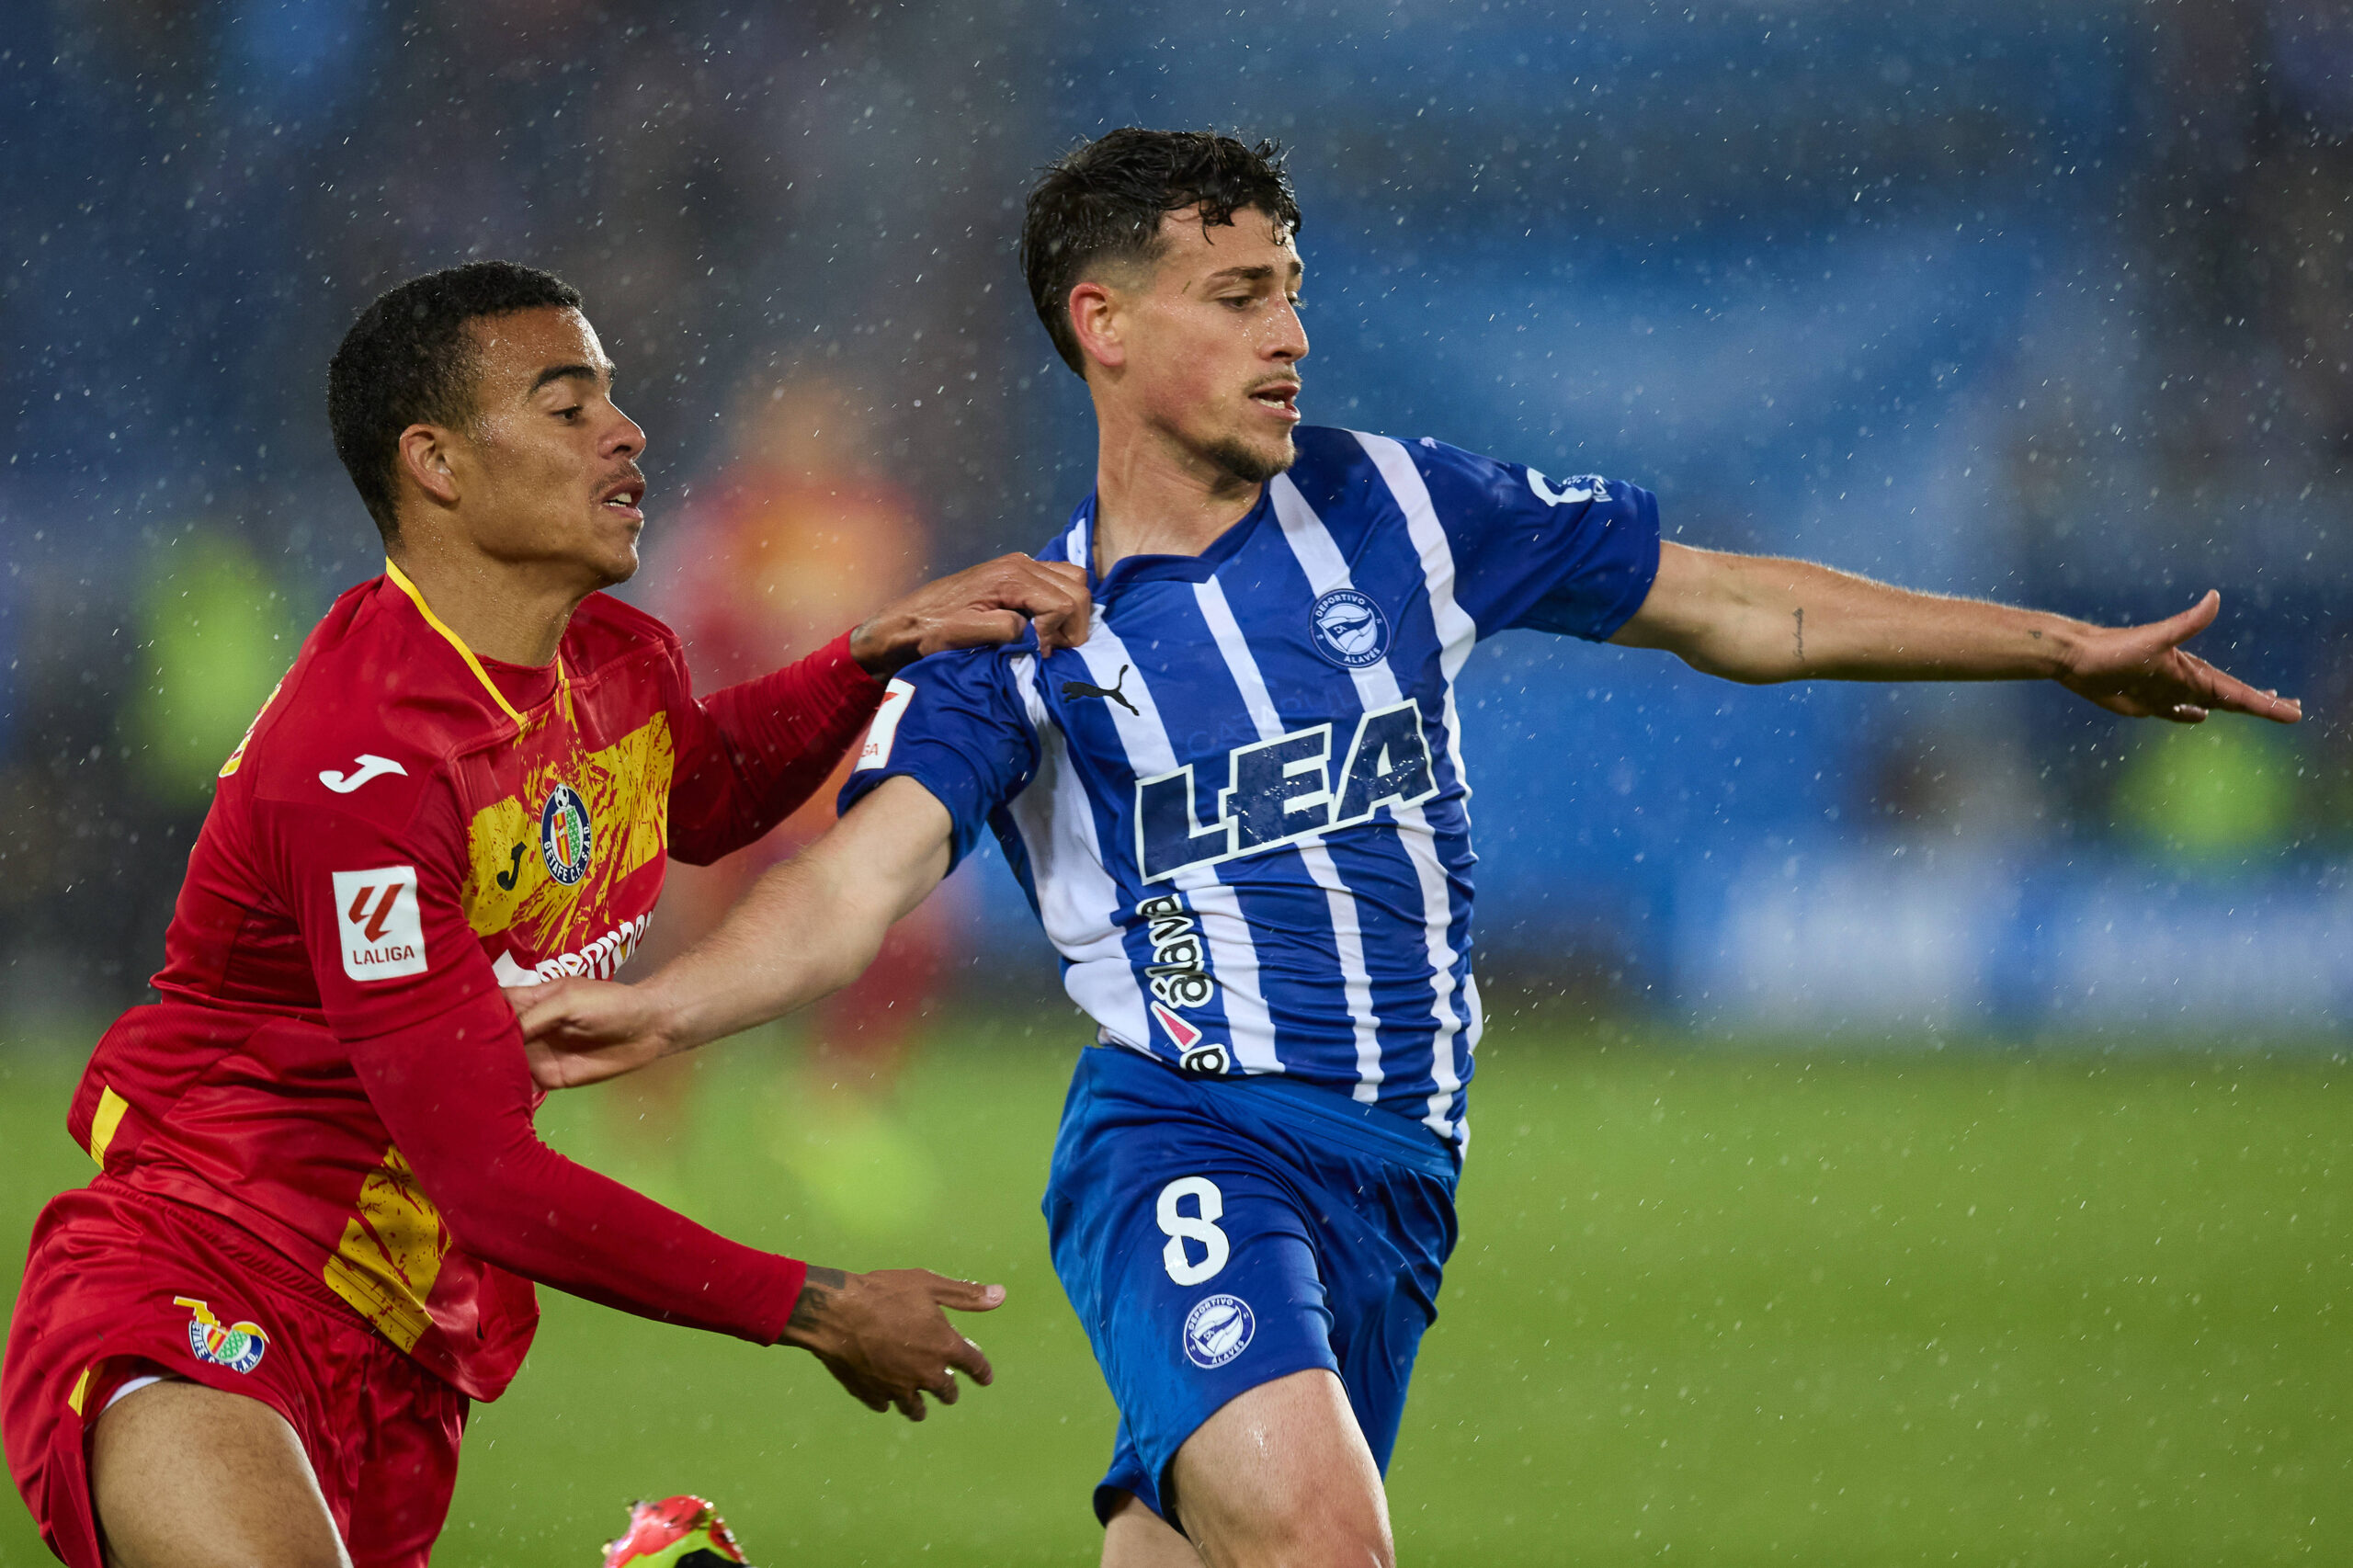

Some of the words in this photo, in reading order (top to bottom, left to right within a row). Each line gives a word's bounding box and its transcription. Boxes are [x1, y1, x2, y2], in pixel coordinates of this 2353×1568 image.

[1315, 595, 1366, 617] DEPORTIVO
[1134, 698, 1440, 886] LEA
[543, 840, 568, 881] GETAFE
[570, 862, 584, 881] C.F.
[581, 823, 591, 861] S.A.D.
[353, 945, 415, 965] LALIGA
[1156, 1176, 1230, 1287] 8
[1188, 1298, 1233, 1331] DEPORTIVO
